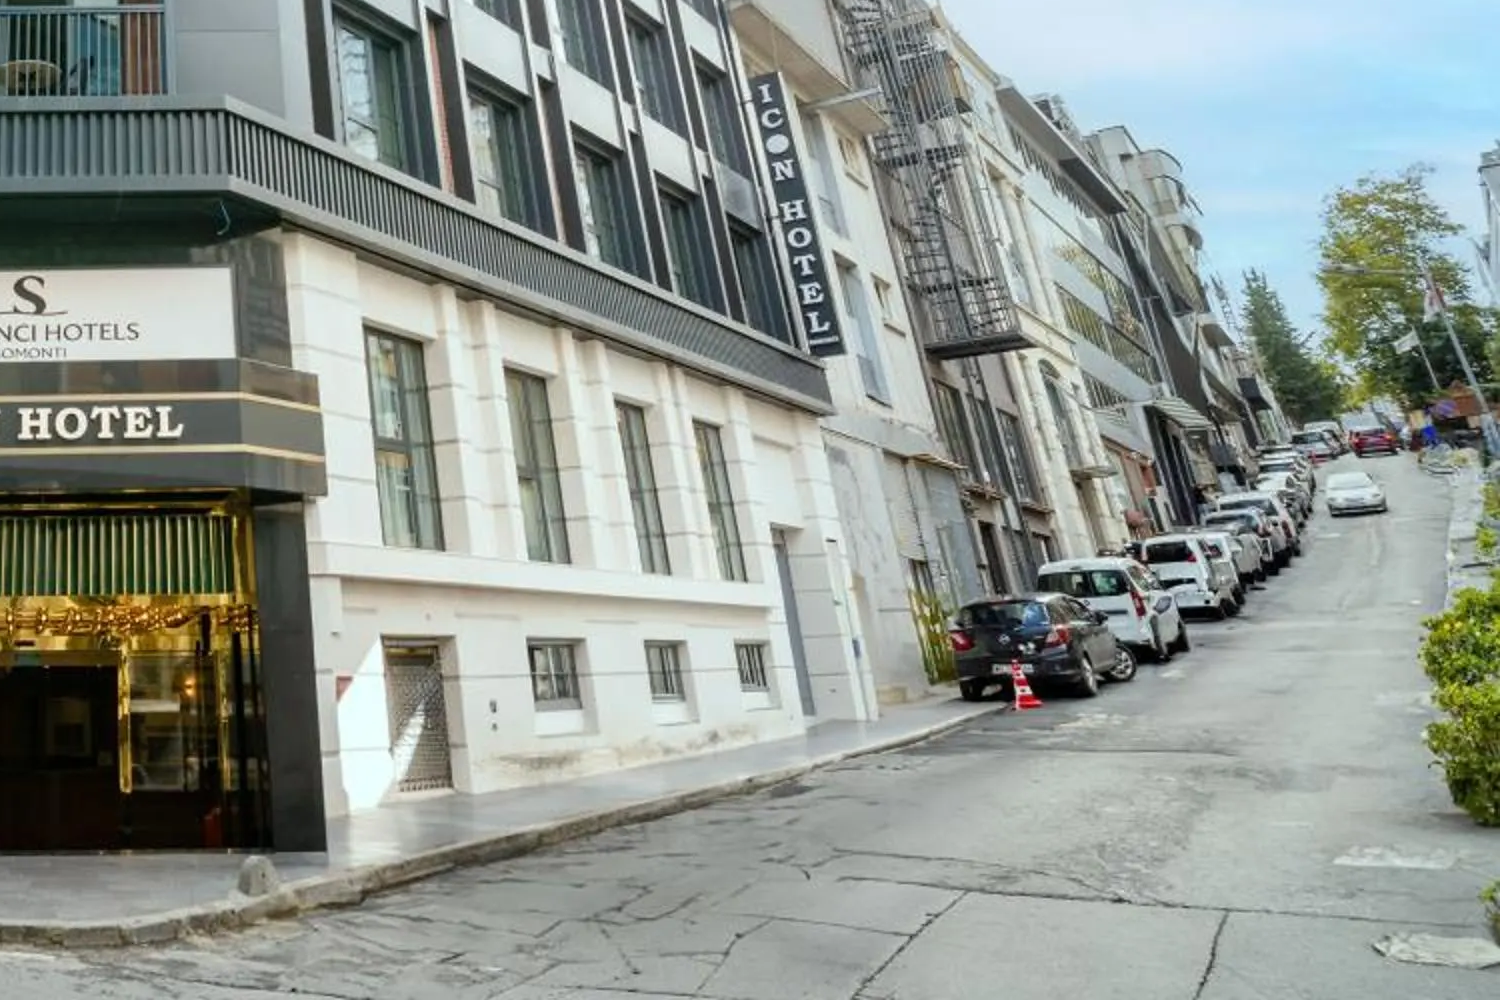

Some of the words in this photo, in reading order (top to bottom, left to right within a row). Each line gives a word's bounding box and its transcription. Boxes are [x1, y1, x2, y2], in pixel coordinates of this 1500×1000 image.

[758, 83, 796, 181] ICON
[780, 199, 831, 333] HOTEL
[13, 275, 48, 315] S
[45, 322, 140, 342] HOTELS
[17, 405, 184, 440] HOTEL
